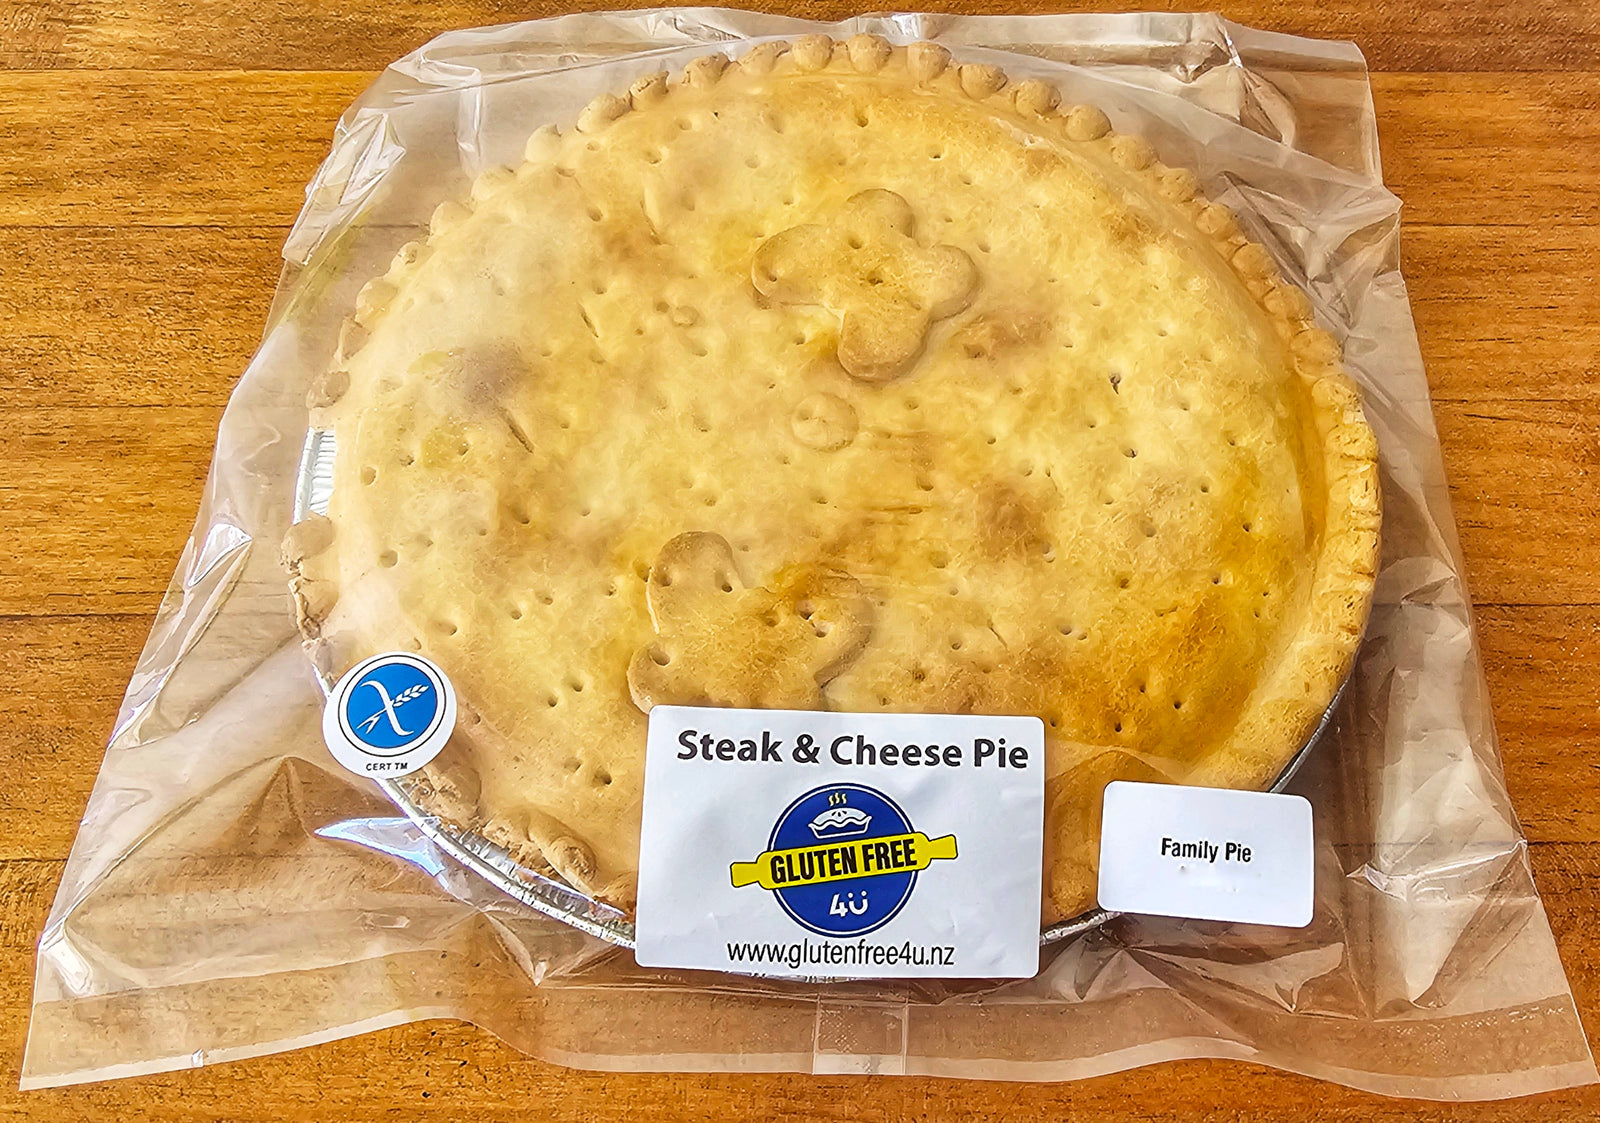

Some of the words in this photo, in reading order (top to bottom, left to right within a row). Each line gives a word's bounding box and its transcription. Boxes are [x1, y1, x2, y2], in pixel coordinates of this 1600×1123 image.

[677, 730, 784, 763] Steak
[792, 733, 820, 764] &
[829, 735, 962, 767] Cheese
[973, 738, 1029, 769] Pie
[365, 762, 392, 772] CERT
[394, 762, 408, 770] TM
[769, 848, 858, 884] GLUTEN
[862, 837, 918, 870] FREE
[1161, 837, 1219, 863] Family
[1225, 842, 1252, 863] Pie
[727, 938, 956, 968] www.glutenfree4u.nz
